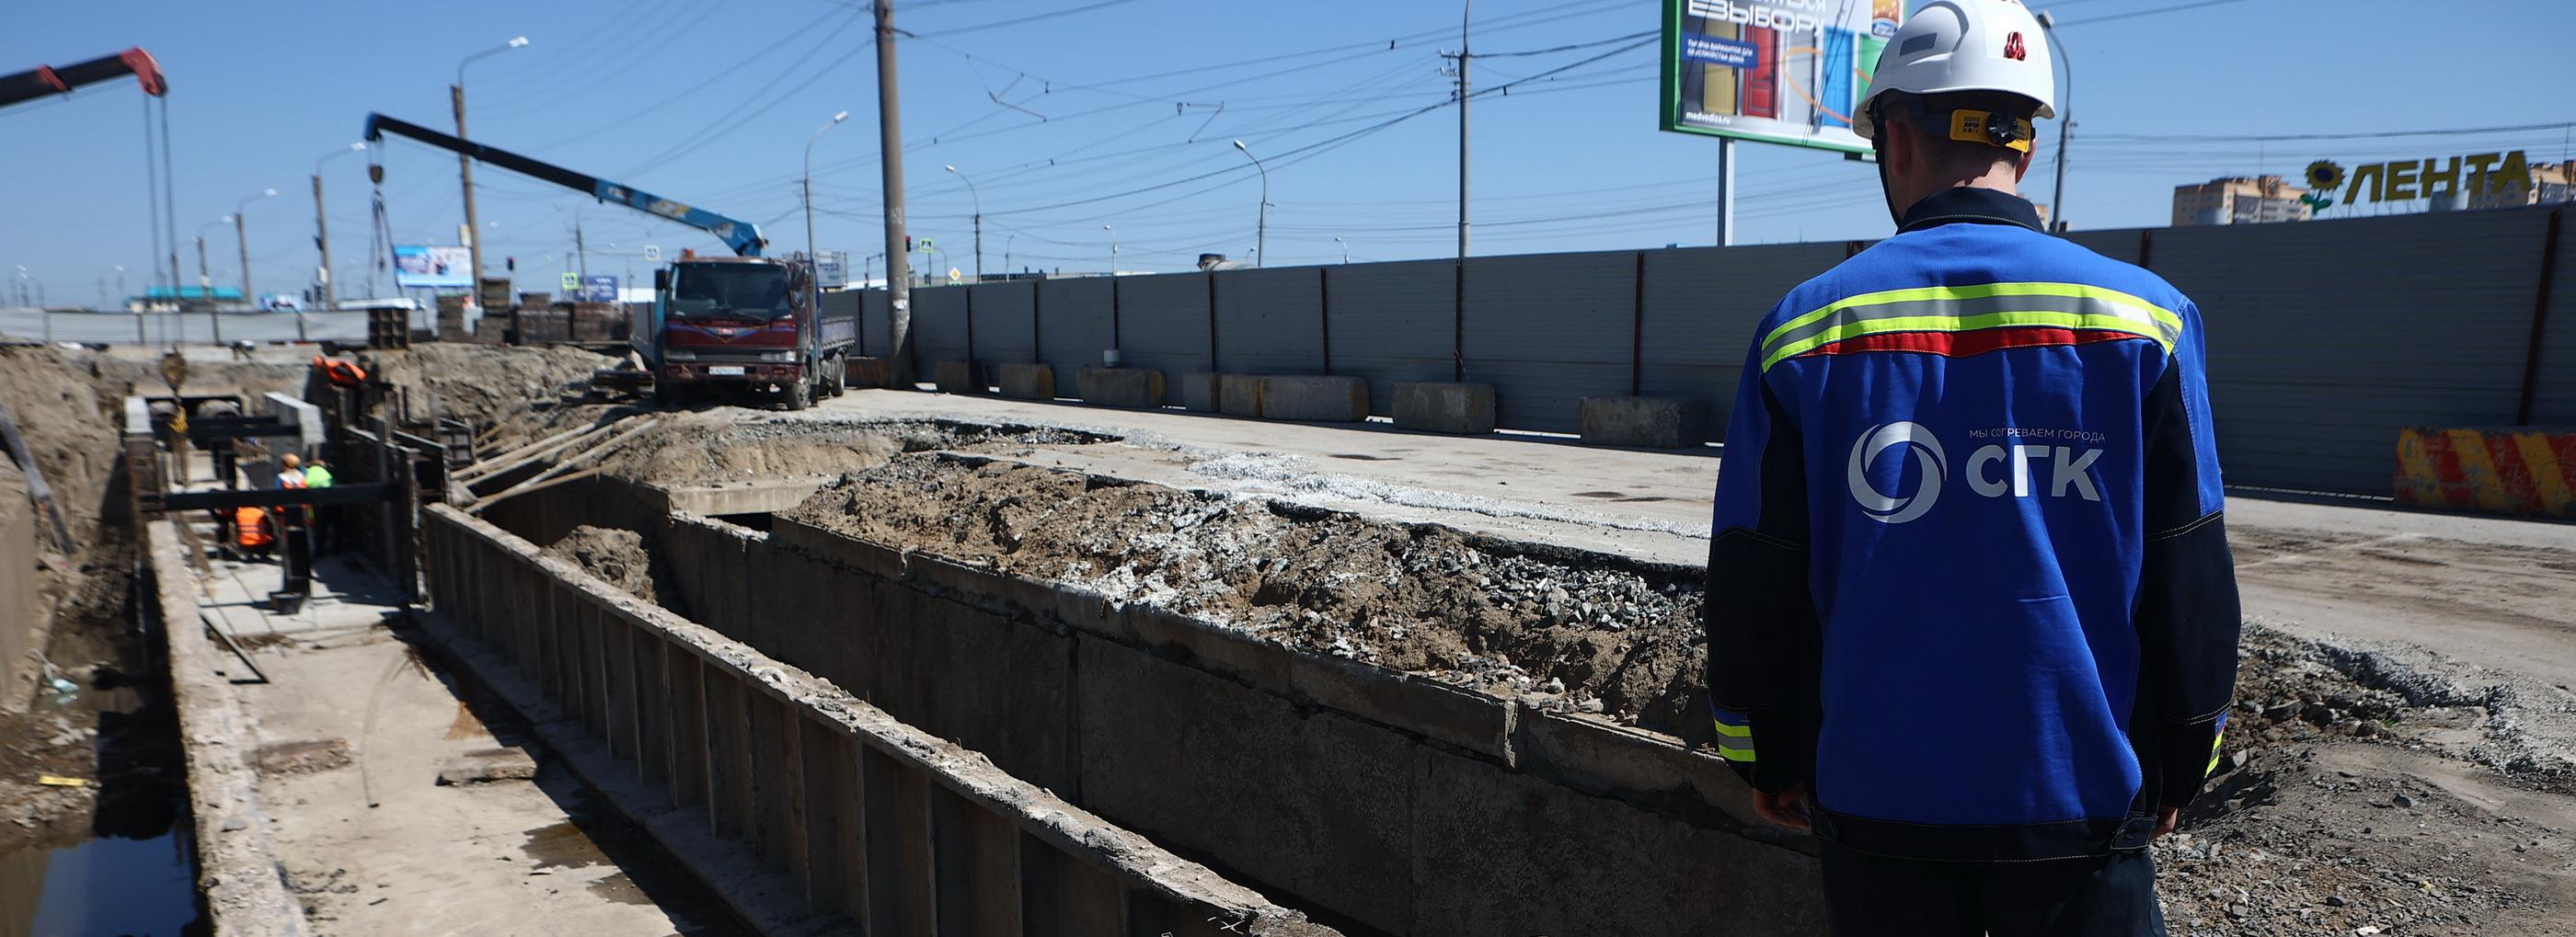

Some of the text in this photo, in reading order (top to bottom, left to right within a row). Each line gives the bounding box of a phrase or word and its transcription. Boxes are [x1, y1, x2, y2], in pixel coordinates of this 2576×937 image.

[2342, 150, 2531, 205] ЛЕНТА
[1969, 428, 2106, 443] МЫ СОГРЕВАЕМ ГОРОДА
[1965, 444, 2104, 502] СГК
